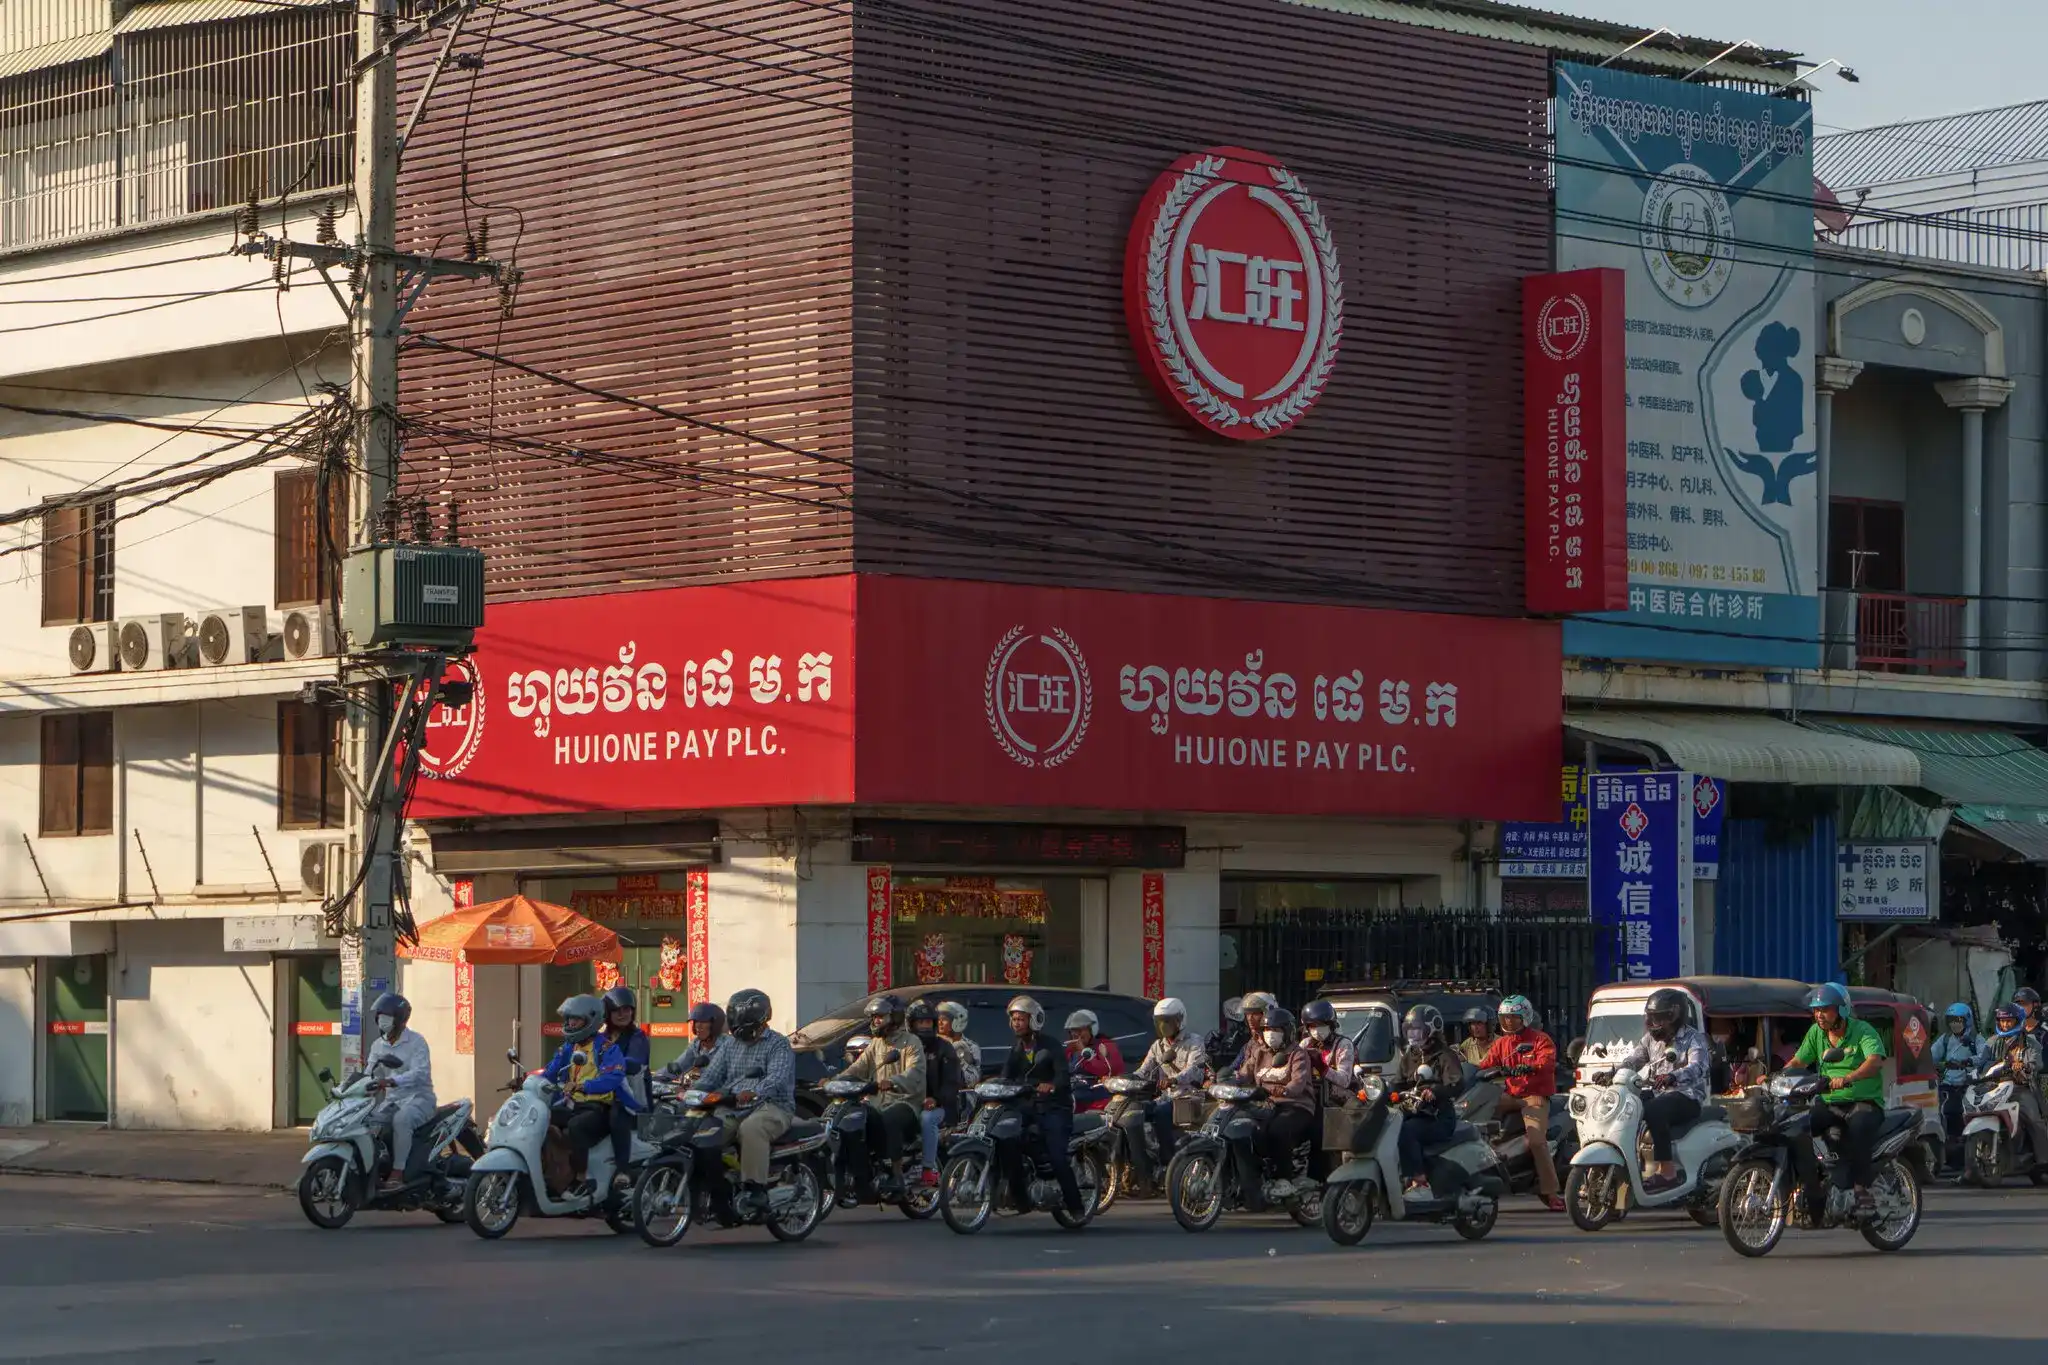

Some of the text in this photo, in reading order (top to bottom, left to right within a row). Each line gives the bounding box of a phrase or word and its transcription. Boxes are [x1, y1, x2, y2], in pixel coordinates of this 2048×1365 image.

[1188, 243, 1304, 332] 汇旺
[1547, 315, 1579, 338] 汇旺
[1556, 373, 1588, 483] ហួយវ័ន
[1547, 409, 1561, 563] HUIONE PAY PLC.
[1565, 493, 1584, 528] ផេ
[1630, 586, 1764, 621] 中医院合作诊所
[508, 640, 667, 738] ហួយវ័ន
[684, 649, 734, 708] ផេ
[1008, 672, 1070, 715] 汇旺
[1119, 648, 1297, 734] ហួយវ័ន
[1313, 669, 1364, 723] ផេ
[554, 725, 788, 765] HUIONE PAY PLC.
[1174, 733, 1416, 773] HUIONE PAY PLC.
[1842, 876, 1923, 893] 中华诊所
